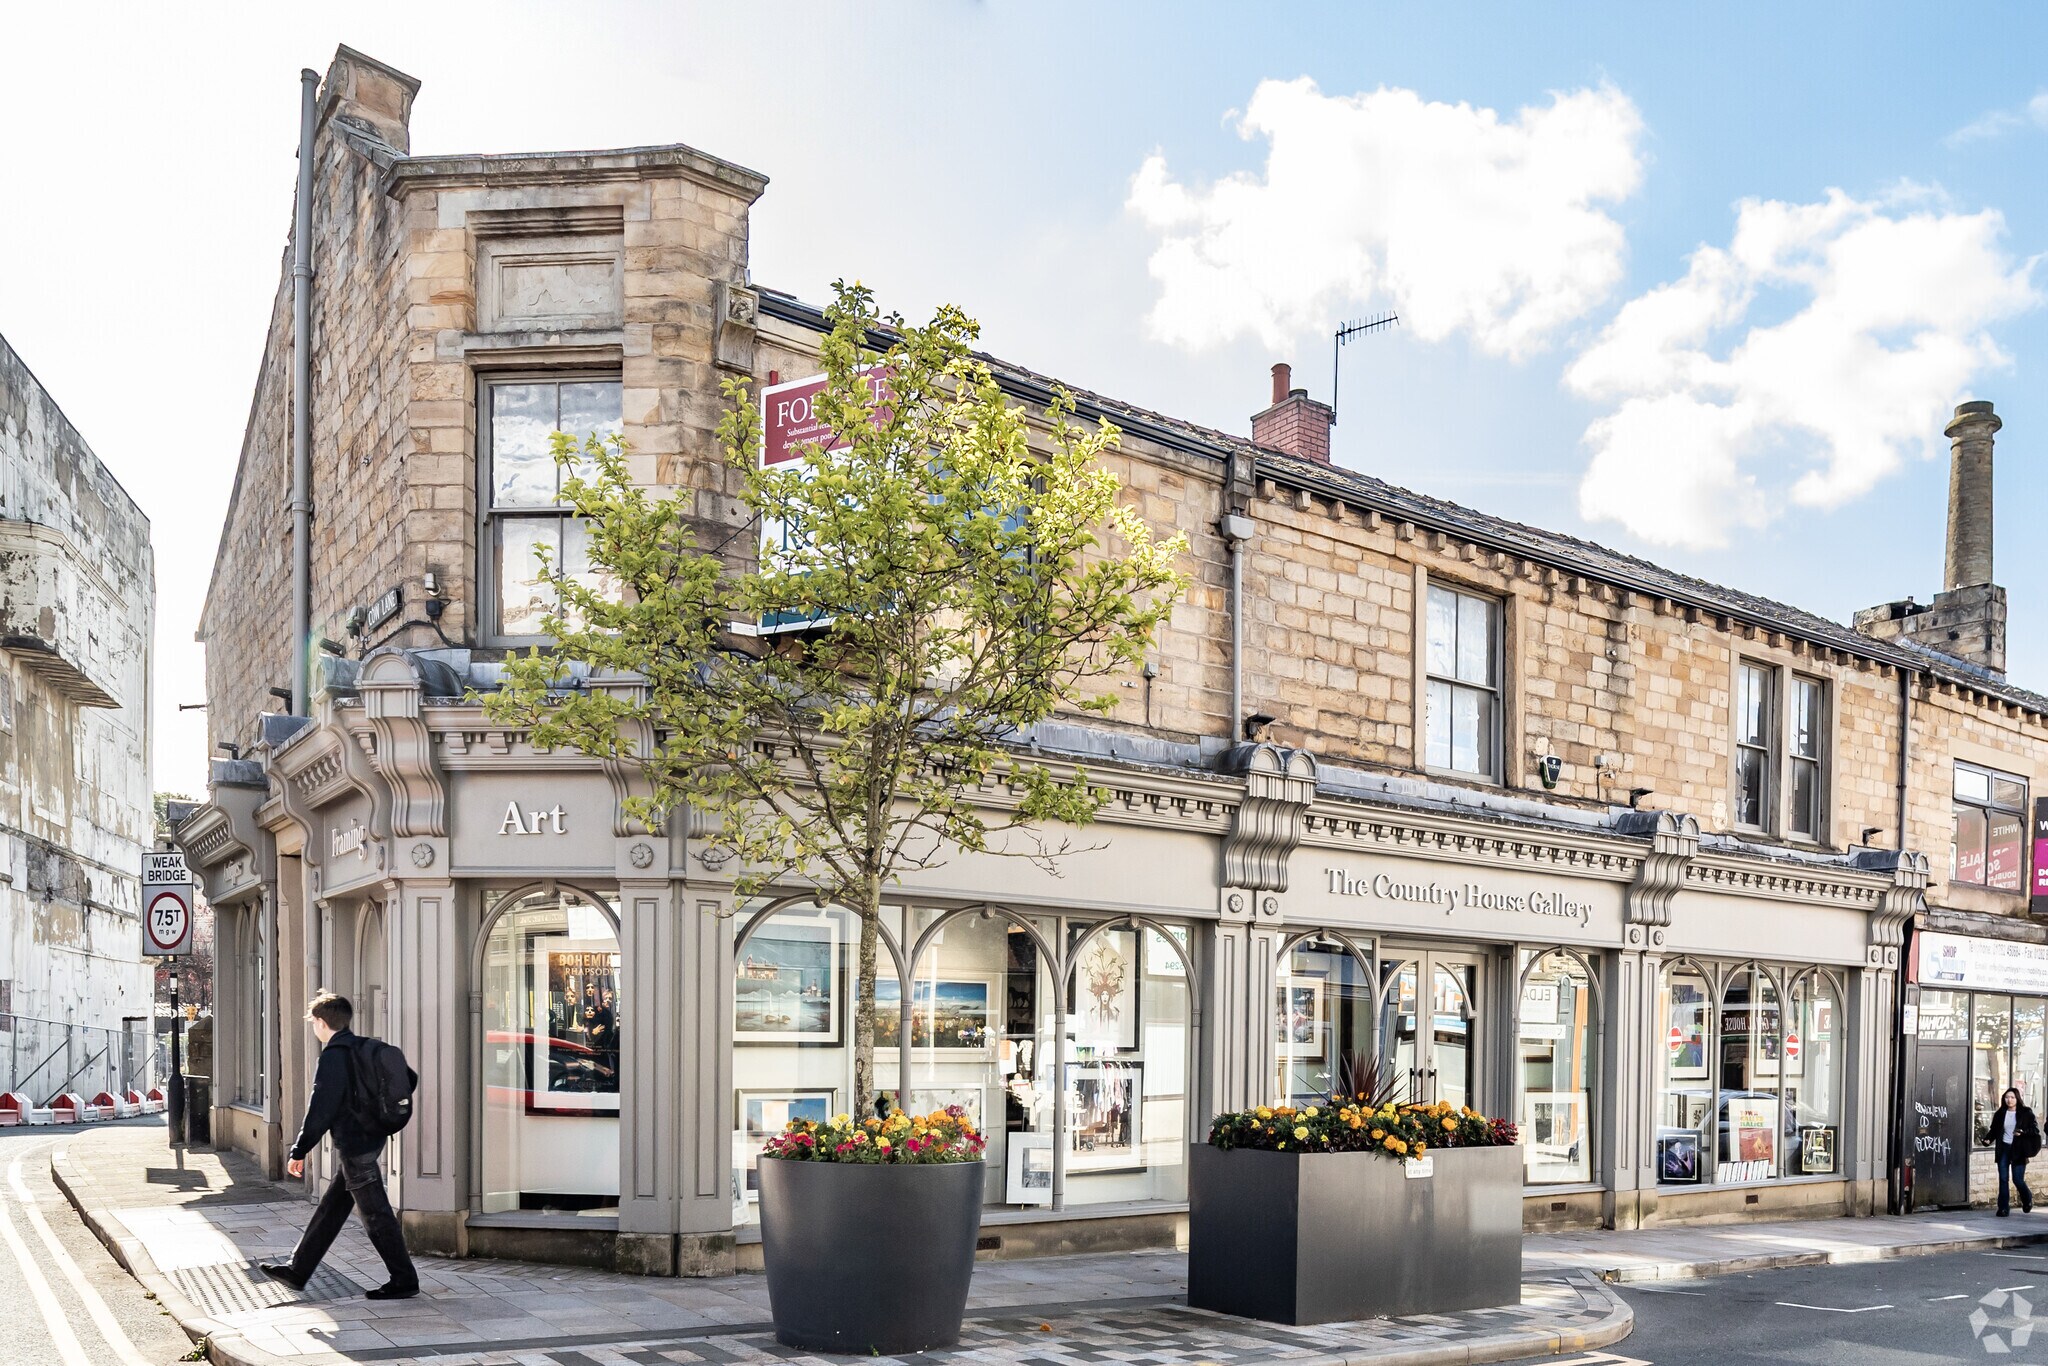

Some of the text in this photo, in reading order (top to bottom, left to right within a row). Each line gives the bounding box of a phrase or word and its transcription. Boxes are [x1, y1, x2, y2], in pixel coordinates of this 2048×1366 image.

[786, 423, 818, 437] Substantial
[368, 590, 396, 626] COW LANE
[497, 800, 568, 836] Art
[331, 818, 368, 862] Framing
[152, 856, 182, 868] WEAK
[148, 869, 187, 882] BRIDGE
[1324, 867, 1594, 928] The Country House Gallery
[154, 909, 181, 926] 7.5T
[1943, 944, 1957, 958] SHOP
[559, 954, 612, 967] BOHEMIA
[565, 967, 615, 976] RHAPSODY
